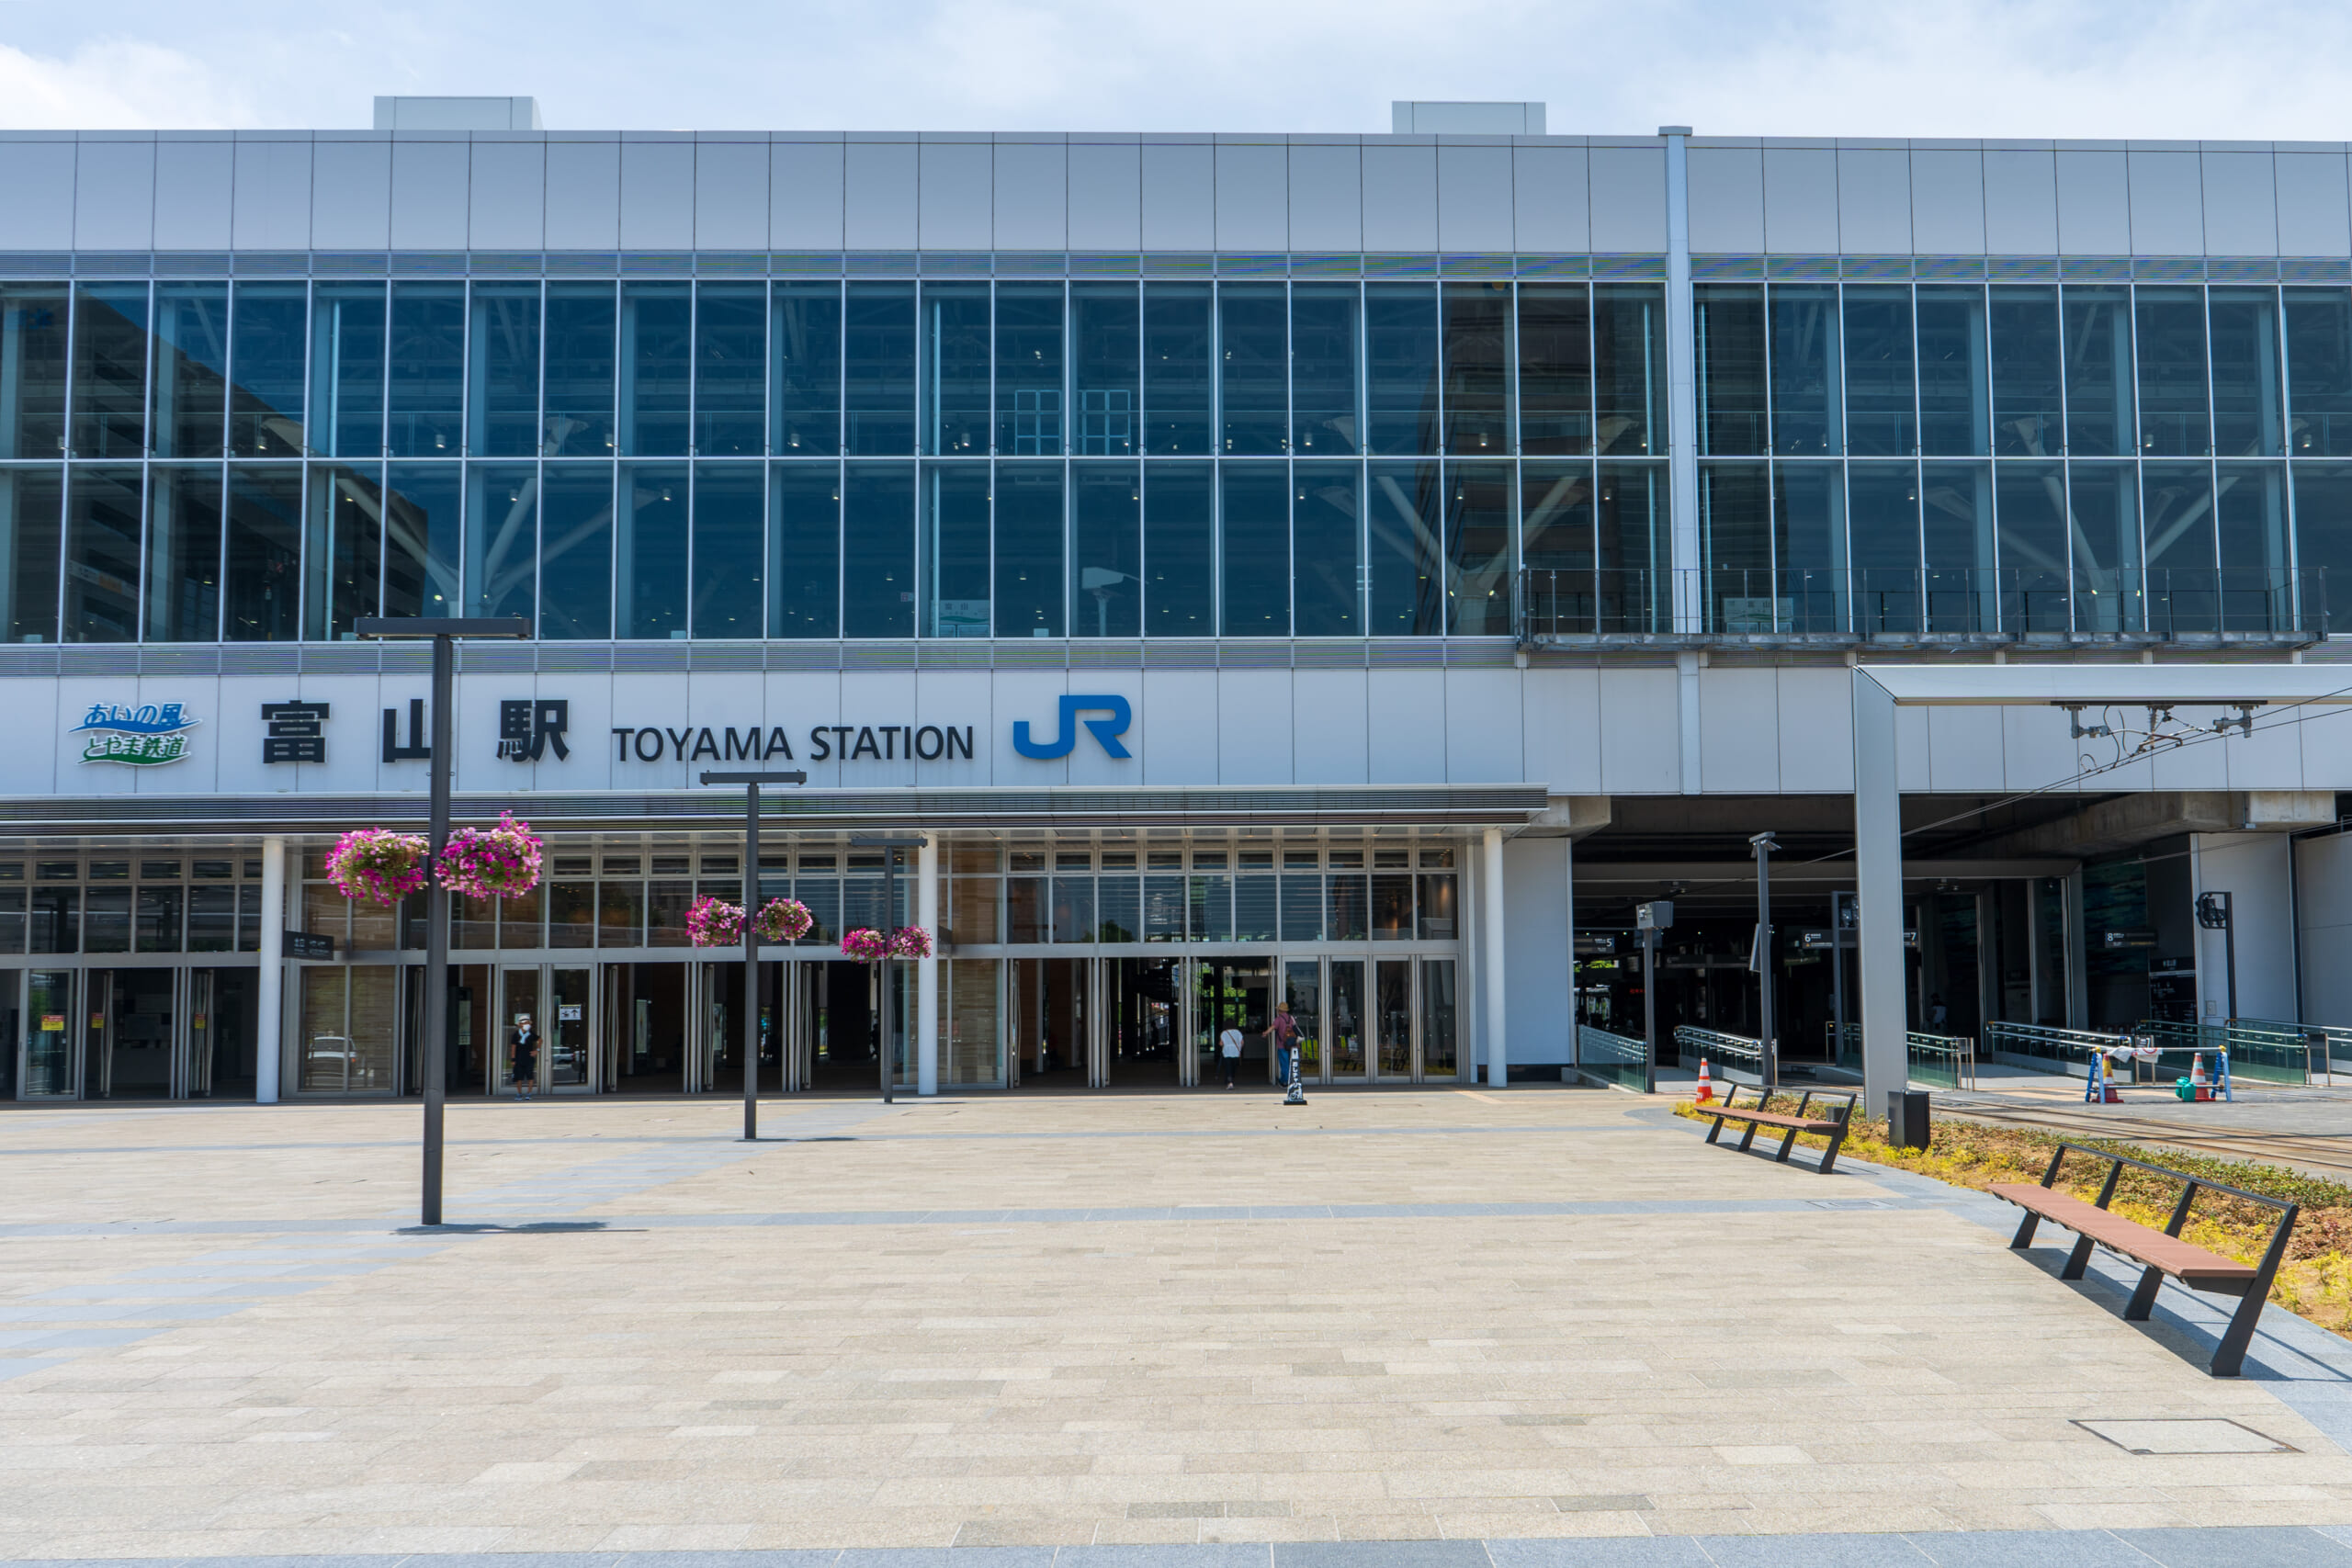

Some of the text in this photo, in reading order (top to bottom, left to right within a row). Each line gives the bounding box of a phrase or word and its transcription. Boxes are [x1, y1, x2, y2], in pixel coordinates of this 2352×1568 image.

[84, 702, 185, 726] あいの風
[261, 699, 570, 763] 富山駅
[1012, 694, 1132, 760] JR
[83, 736, 187, 757] とやま鉄道
[612, 726, 974, 761] TOYAMA STATION
[1606, 938, 1612, 947] 5
[1804, 933, 1811, 942] 6
[1910, 932, 1916, 941] 7
